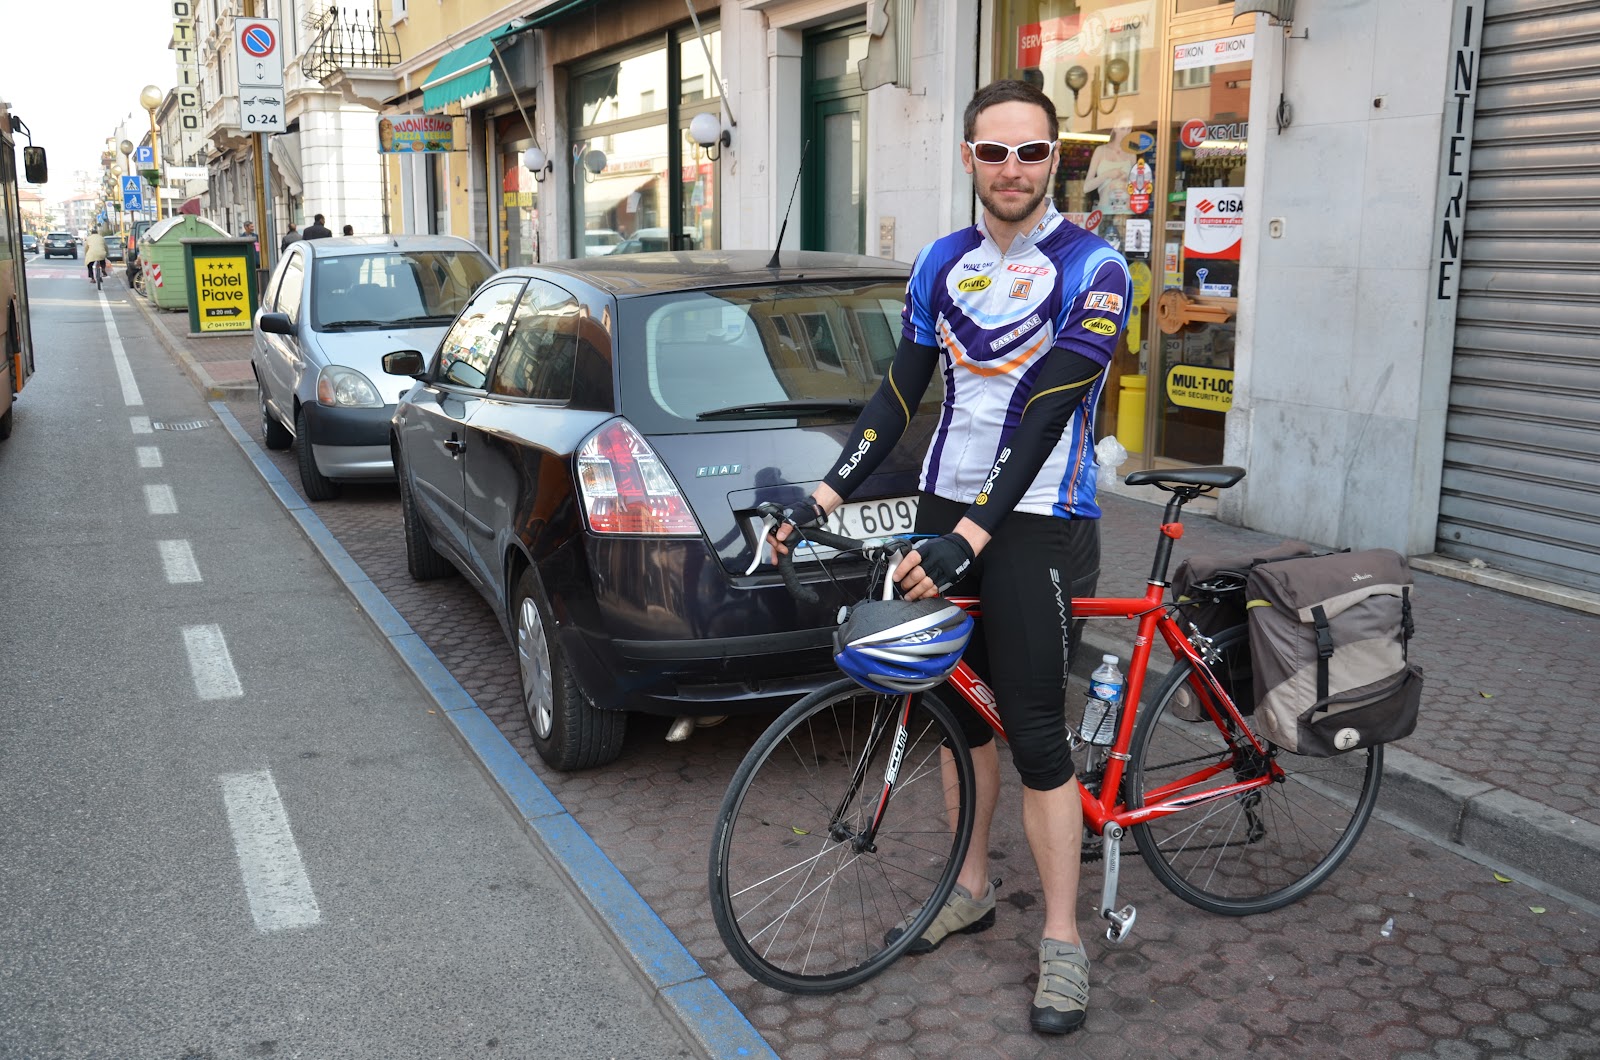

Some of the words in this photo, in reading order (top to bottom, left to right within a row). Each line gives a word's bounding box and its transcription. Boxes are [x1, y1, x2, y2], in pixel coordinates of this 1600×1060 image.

[1021, 30, 1057, 49] SERVICE
[174, 2, 197, 129] OTTICO
[247, 114, 278, 125] 0-24
[393, 117, 452, 132] BUONISSIMO
[394, 132, 420, 140] PIZZA
[423, 131, 451, 140] KEBAB
[1217, 200, 1244, 212] CISA
[1086, 211, 1101, 229] QUI
[1009, 264, 1049, 276] TIME
[202, 272, 242, 287] Hotel
[202, 288, 244, 302] Piave
[1088, 293, 1110, 309] FL
[1089, 321, 1113, 332] MAVIC
[1171, 388, 1186, 397] HIGH
[1188, 391, 1219, 402] SECURITY
[838, 438, 871, 479] SKINS
[698, 464, 740, 476] FIAT
[982, 446, 1012, 495] SKINS
[1049, 568, 1069, 689] NORTHWAVE
[886, 725, 908, 784] SCOTT
